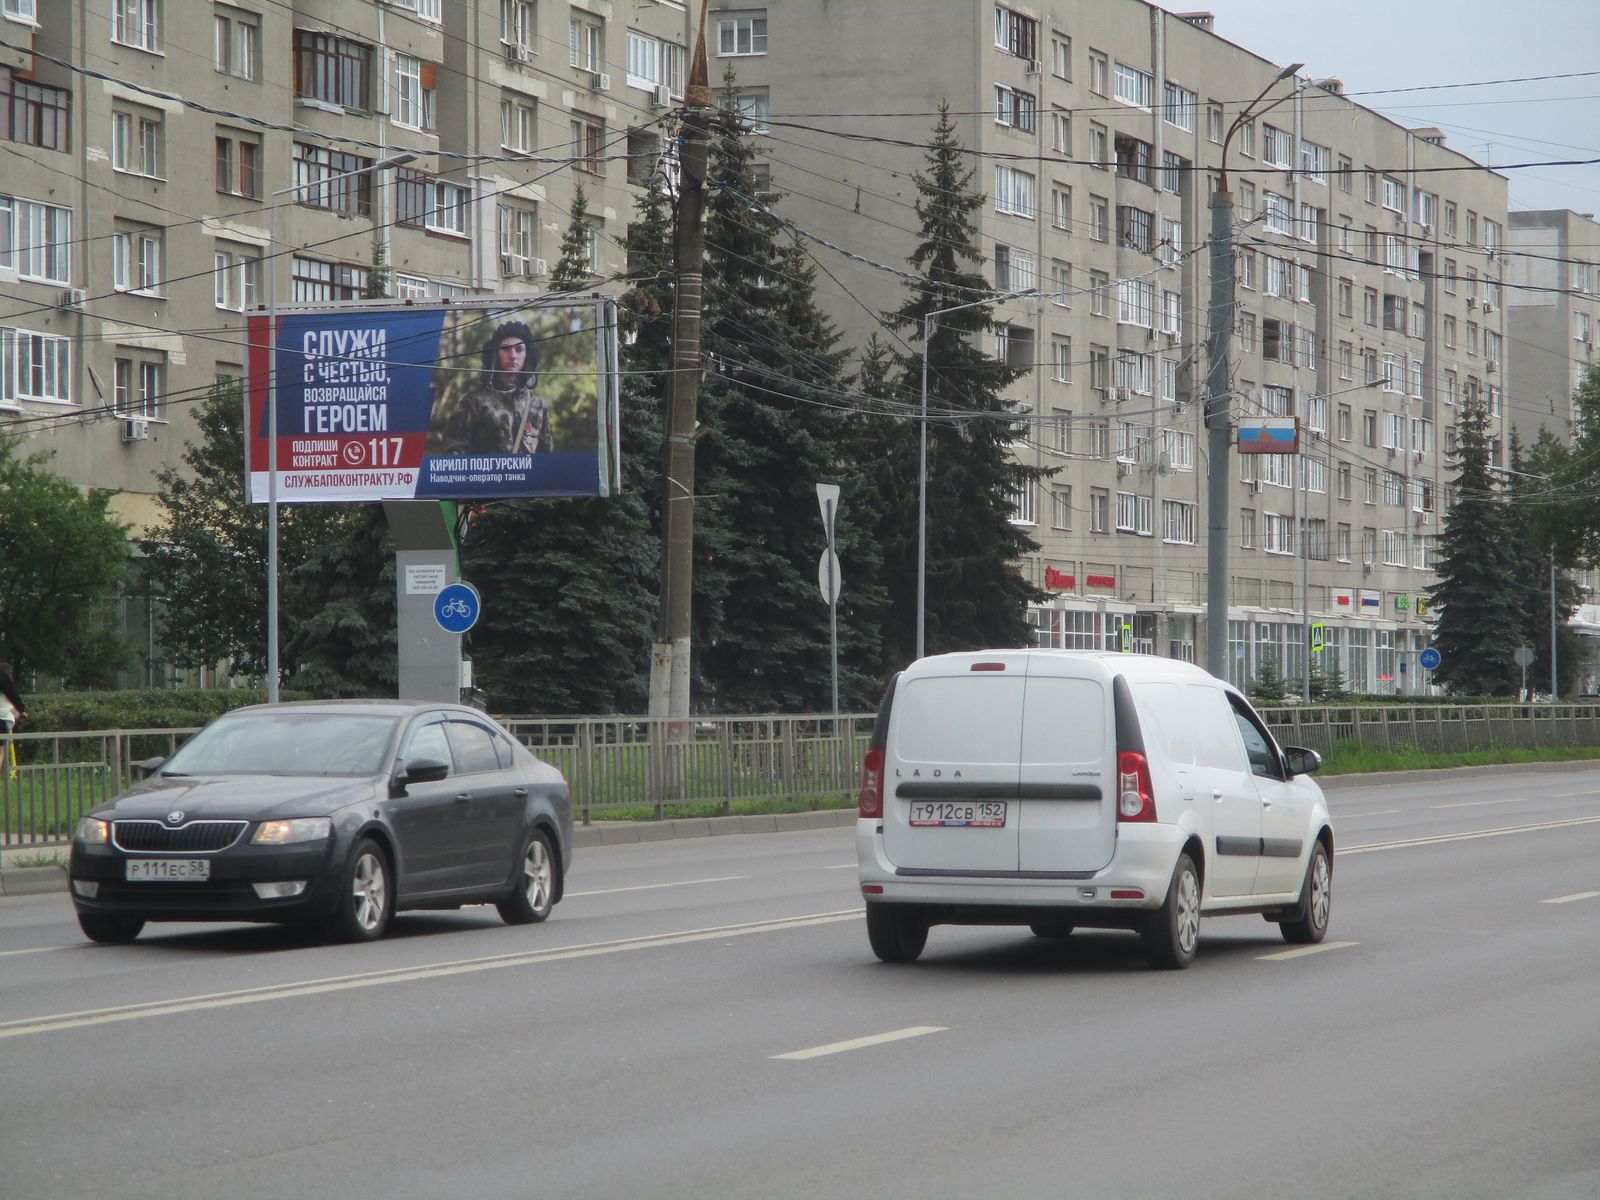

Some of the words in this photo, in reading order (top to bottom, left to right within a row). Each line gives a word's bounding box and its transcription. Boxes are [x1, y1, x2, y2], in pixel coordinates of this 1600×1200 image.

[303, 329, 386, 360] СЛУЖИ
[303, 363, 314, 383] С
[318, 361, 391, 384] ЧЕСТЬЮ,
[304, 384, 387, 403] ВОЗВРАЩАЙСЯ
[304, 404, 387, 433] ГЕРОЕМ
[292, 440, 338, 453] ПОДПИШИ
[369, 438, 403, 465] 117
[292, 454, 338, 467] КОНТРАКТ
[430, 459, 468, 472] КИРИЛЛ
[470, 455, 532, 471] ПОДГУРСКИЙ
[284, 472, 413, 488] СЛУЖБАПОКОНТРАКТУ.РФ
[430, 473, 503, 484] Наводчик-оператор
[505, 472, 526, 481] танка
[895, 769, 962, 778] LADA
[978, 803, 1002, 816] 152
[191, 861, 204, 872] 58
